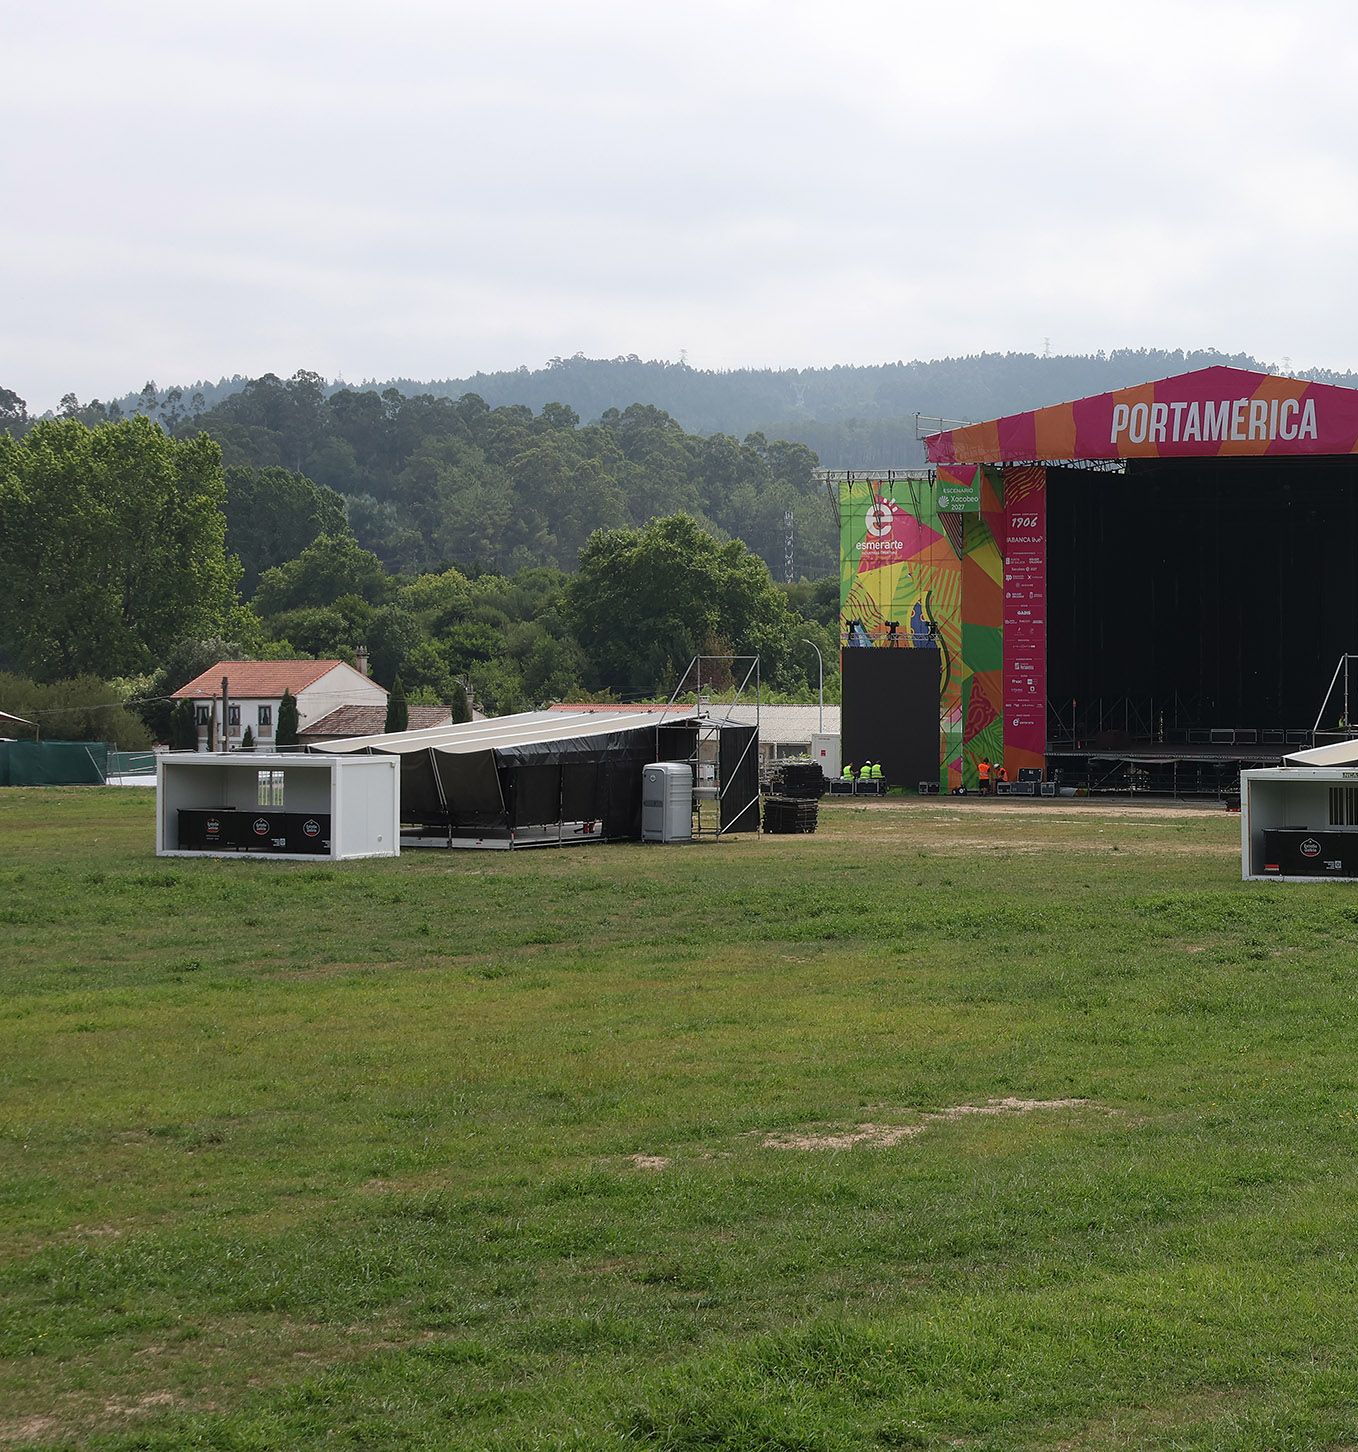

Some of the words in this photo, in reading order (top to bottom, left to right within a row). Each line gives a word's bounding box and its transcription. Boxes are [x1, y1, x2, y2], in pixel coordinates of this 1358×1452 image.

[1110, 397, 1318, 444] PORTAMÉRICA
[950, 495, 979, 503] Xacobeo
[951, 503, 965, 511] 2027
[1011, 516, 1038, 528] 1906
[856, 540, 904, 550] esmerarte
